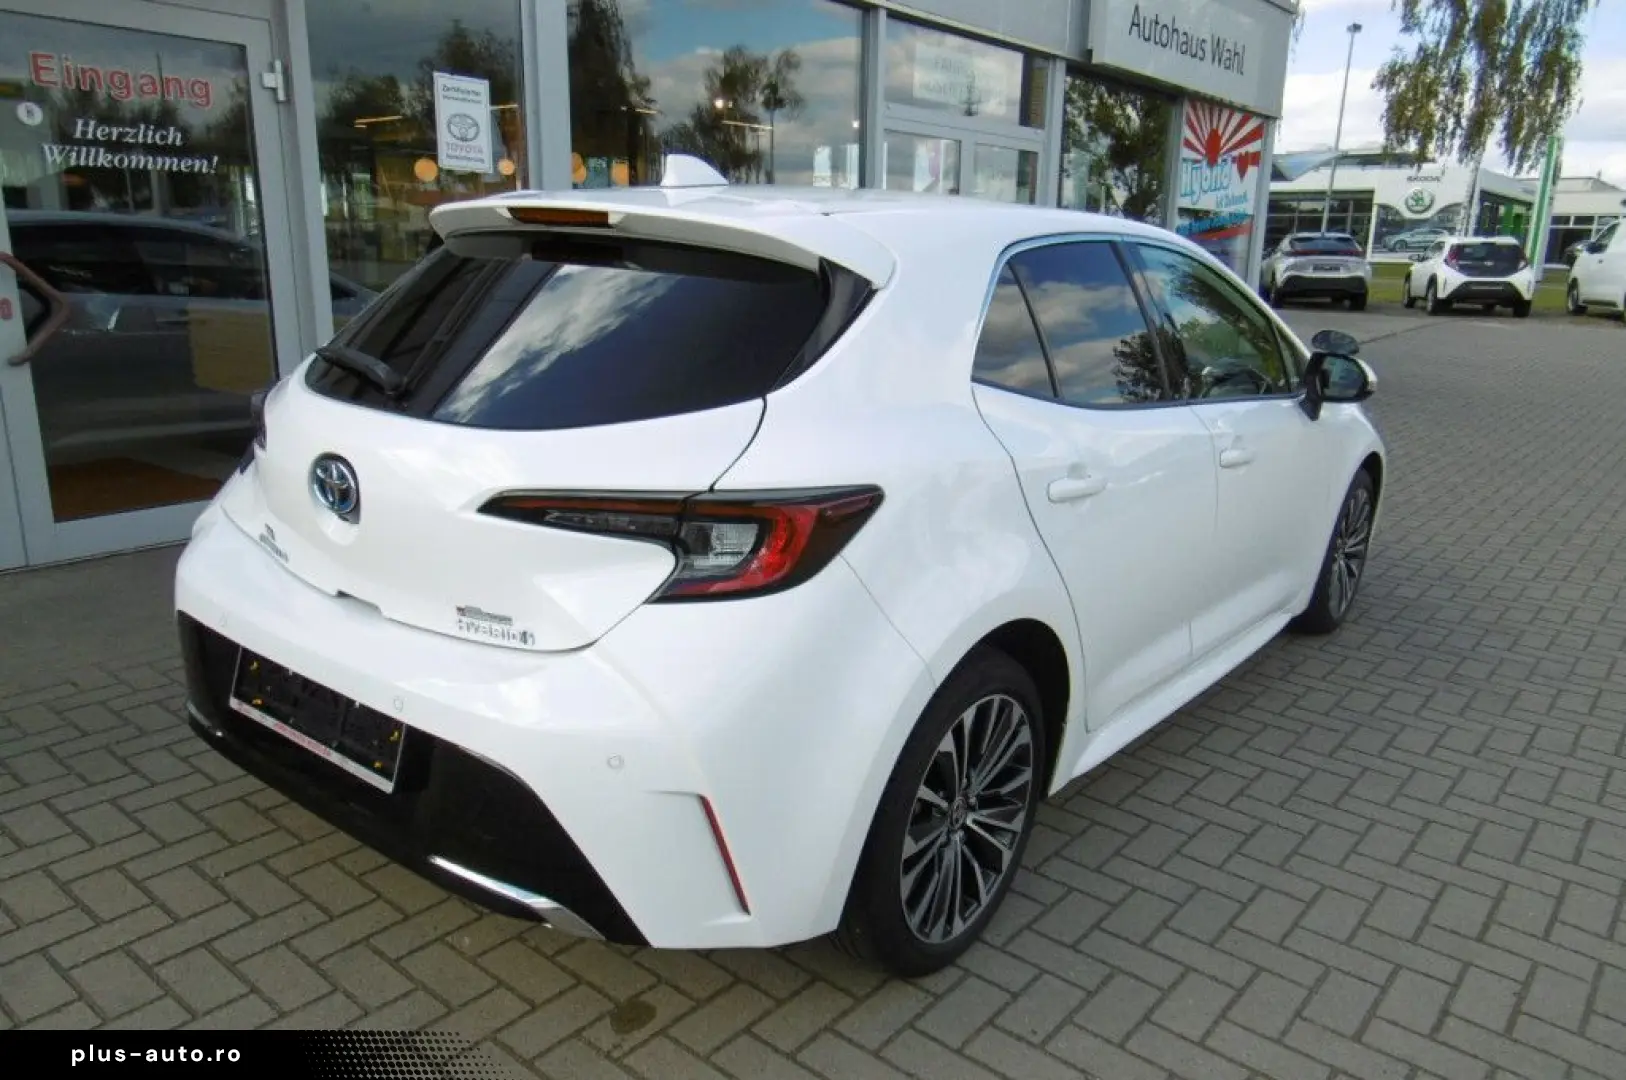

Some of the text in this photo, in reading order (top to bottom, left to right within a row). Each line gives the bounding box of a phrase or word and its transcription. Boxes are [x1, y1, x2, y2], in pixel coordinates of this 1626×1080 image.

[1128, 3, 1246, 76] Autohaus Wahl
[30, 51, 214, 109] Eingang
[73, 117, 183, 146] Herzlich
[446, 142, 484, 155] TOYOTA
[42, 143, 219, 174] Willkommen!
[1179, 156, 1233, 206] Hybrid
